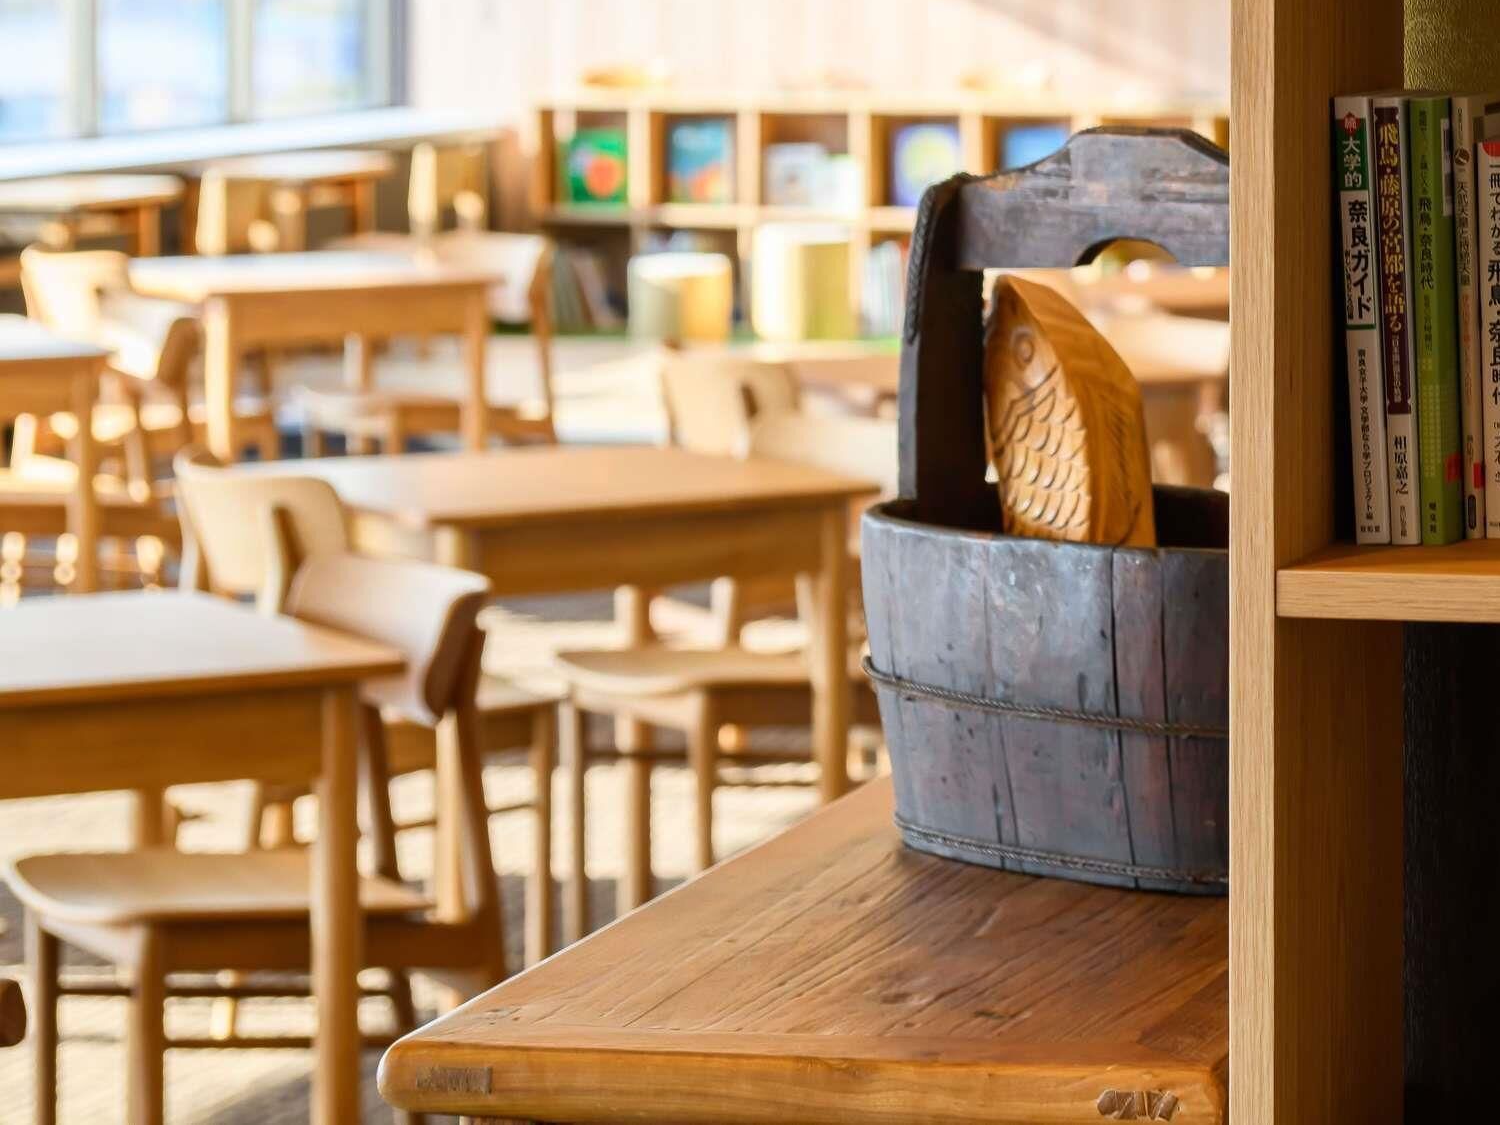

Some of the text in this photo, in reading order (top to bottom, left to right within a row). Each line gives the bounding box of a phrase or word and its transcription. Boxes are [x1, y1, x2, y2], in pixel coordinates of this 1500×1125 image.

[1342, 136, 1361, 188] 大学的
[1348, 199, 1372, 320] 奈良ガイド
[1378, 122, 1405, 332] 飛鳥・藤原の宮都を語る
[1417, 197, 1434, 289] 飛鳥・奈良時代
